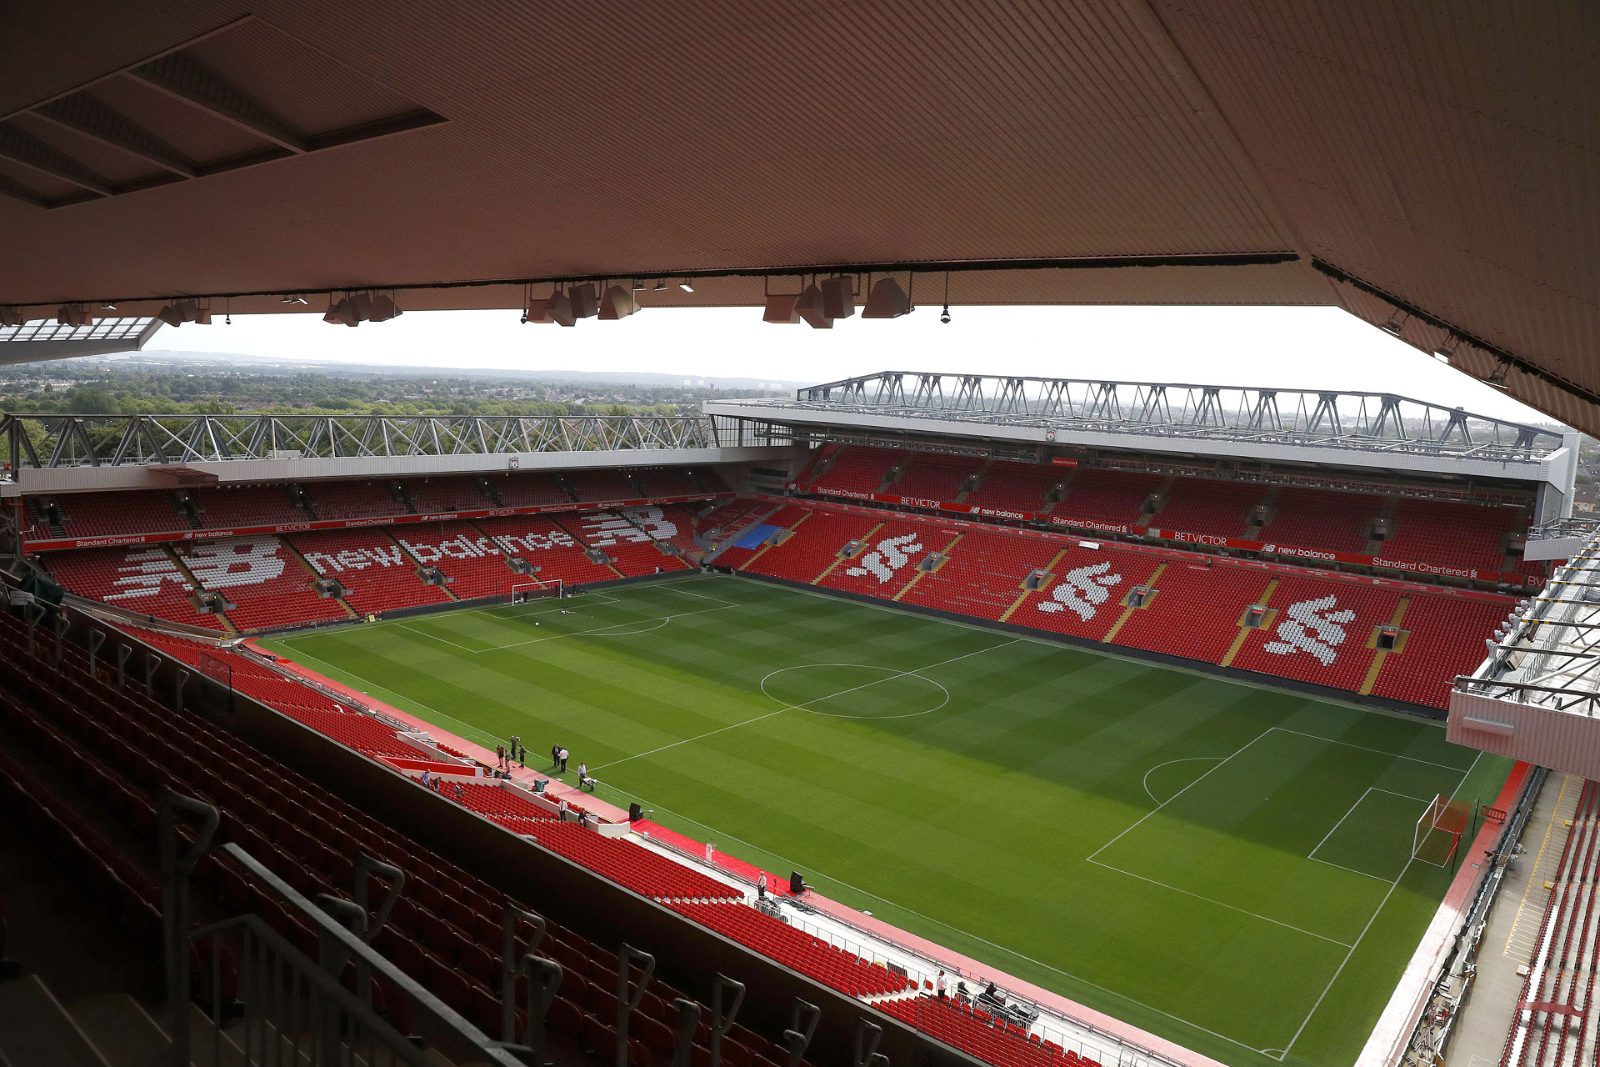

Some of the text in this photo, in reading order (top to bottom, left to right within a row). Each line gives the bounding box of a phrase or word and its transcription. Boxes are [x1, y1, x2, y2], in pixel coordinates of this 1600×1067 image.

[817, 486, 869, 499] Standard Chartered
[981, 508, 996, 516] new
[995, 509, 1024, 519] balance
[1052, 516, 1121, 532] Standard Chartered
[76, 536, 140, 547] Standard Chartered
[1174, 531, 1227, 546] BETVICTOR
[303, 531, 574, 575] new balance
[1278, 546, 1296, 556] new
[1297, 547, 1336, 560] balance
[1372, 556, 1468, 578] Standard Chartered
